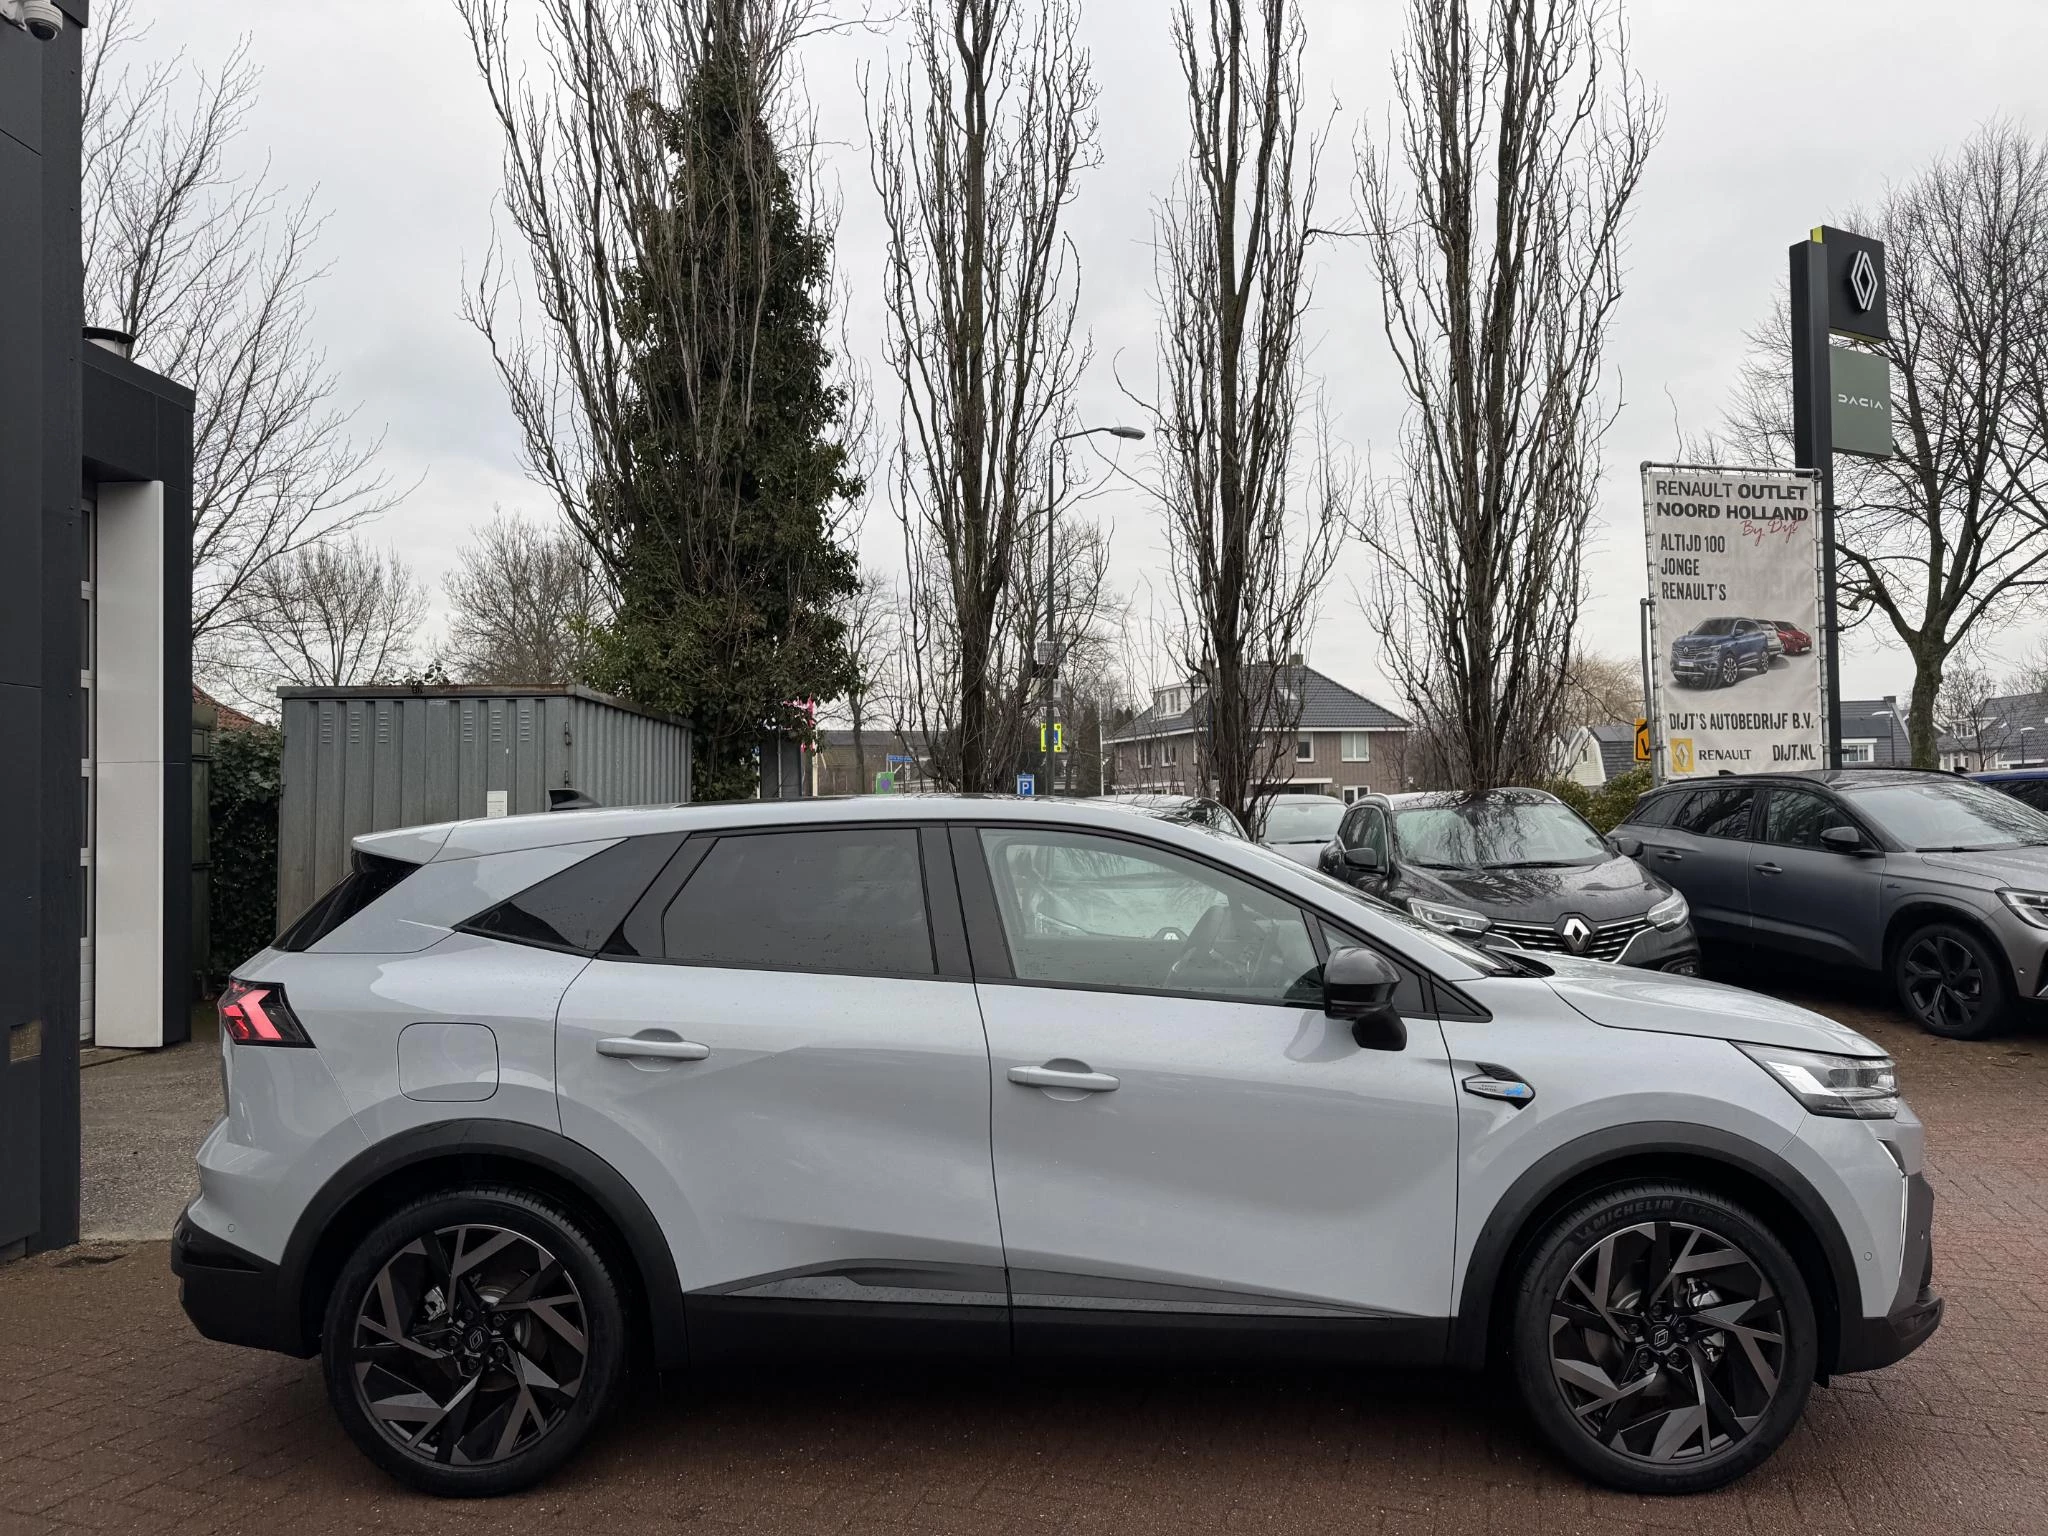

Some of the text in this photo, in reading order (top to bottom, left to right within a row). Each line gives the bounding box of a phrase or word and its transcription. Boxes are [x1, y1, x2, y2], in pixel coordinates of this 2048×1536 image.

[1838, 394, 1883, 410] DACIA
[1656, 480, 1808, 500] RENAULT OUTLET
[1656, 502, 1809, 521] NOORD HOLLAND
[1660, 533, 1725, 553] ALTIJD 100
[1661, 558, 1700, 576] JONGE
[1661, 581, 1726, 601] RENAULT'S
[1669, 712, 1814, 730] DIJT'S AUTOBEDRIJF B.V.
[1698, 749, 1751, 761] RENAULT
[1772, 743, 1816, 761] DIJT.NL
[1022, 782, 1030, 795] P
[1593, 1199, 1675, 1230] MICHELIN
